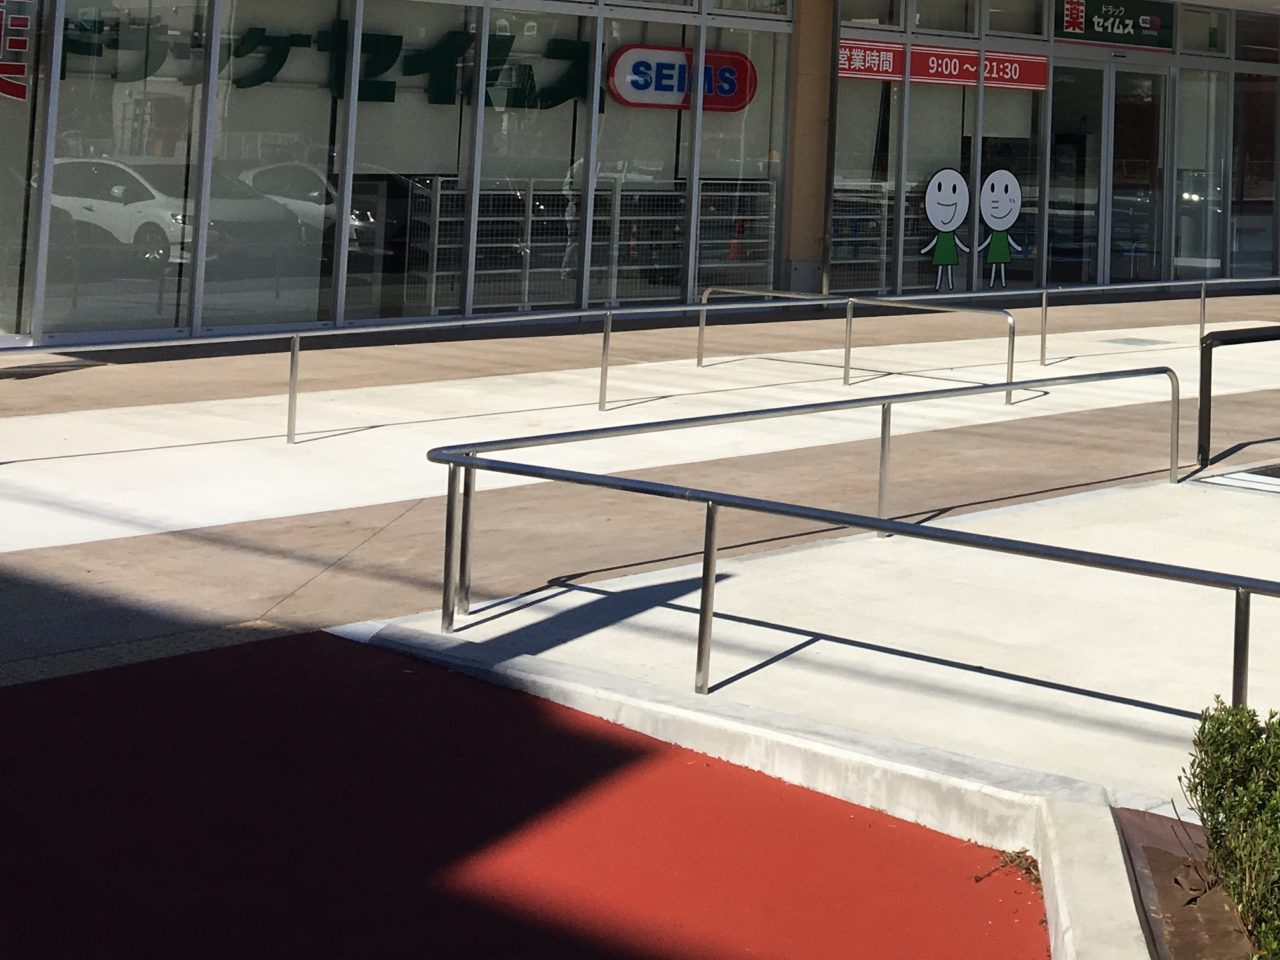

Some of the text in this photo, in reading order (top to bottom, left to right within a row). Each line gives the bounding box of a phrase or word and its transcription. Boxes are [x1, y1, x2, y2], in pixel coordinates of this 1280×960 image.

[1092, 15, 1134, 35] セイムス
[839, 48, 893, 73] 営業時間
[928, 56, 960, 75] 9:00
[984, 60, 1020, 80] 21:30
